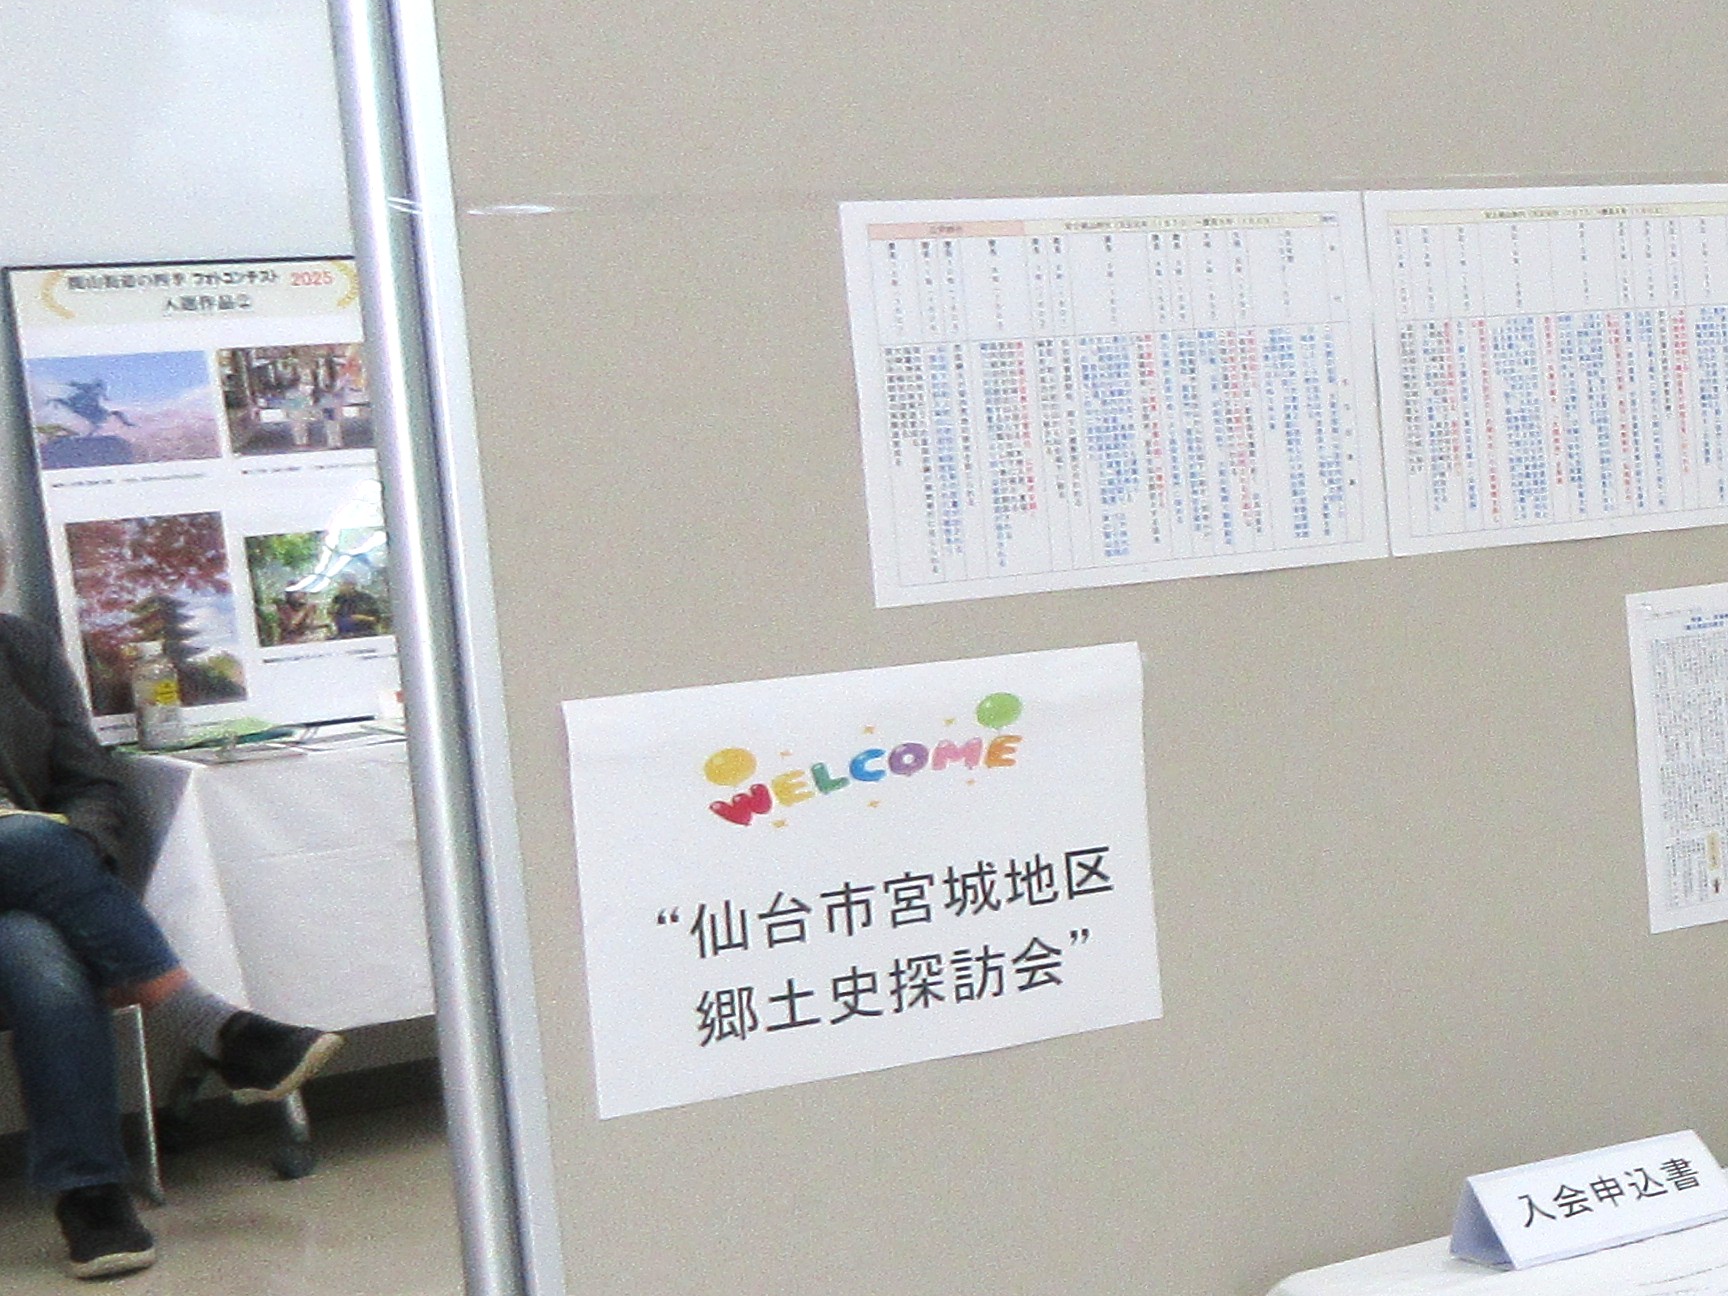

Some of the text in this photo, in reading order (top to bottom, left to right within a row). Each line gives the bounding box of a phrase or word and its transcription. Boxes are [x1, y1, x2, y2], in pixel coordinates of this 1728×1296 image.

[290, 270, 334, 287] 2025
[709, 734, 1023, 826] WELCOME
[1517, 1157, 1702, 1228] 入会申込書
